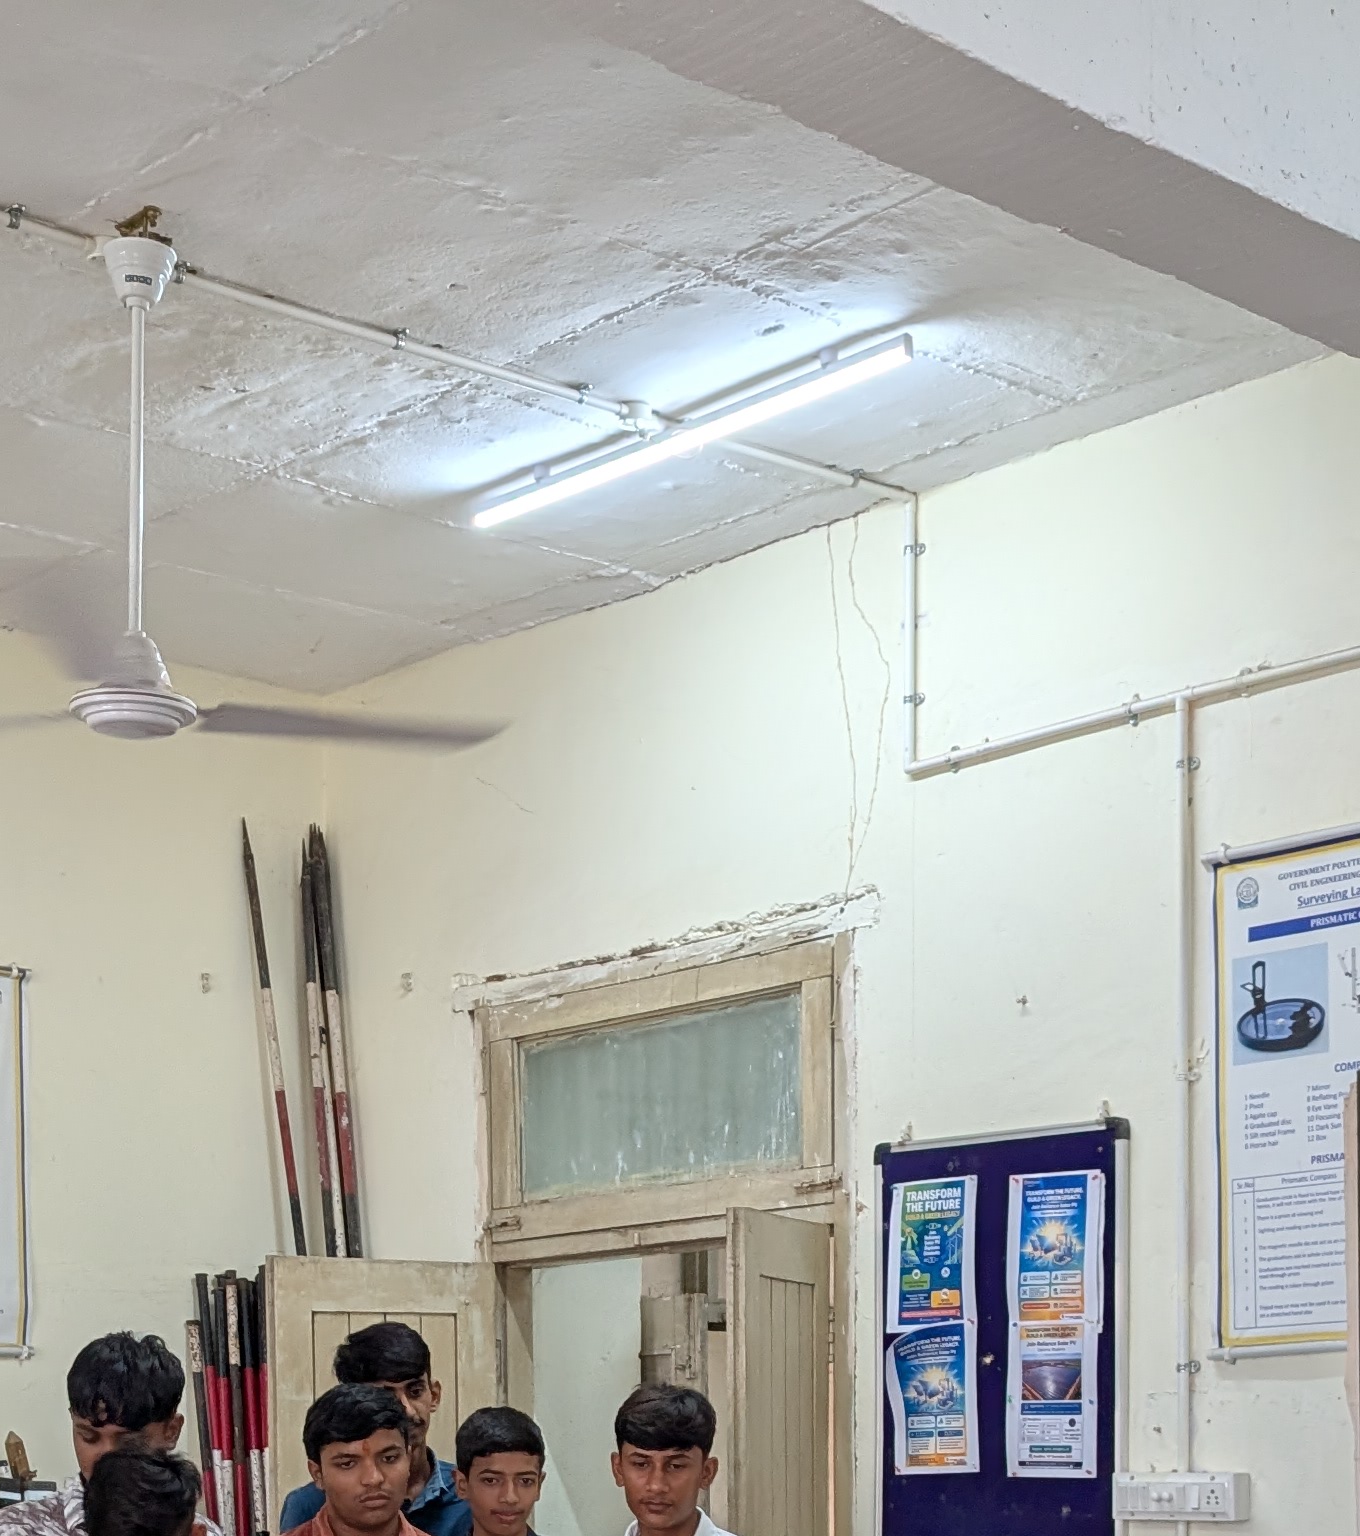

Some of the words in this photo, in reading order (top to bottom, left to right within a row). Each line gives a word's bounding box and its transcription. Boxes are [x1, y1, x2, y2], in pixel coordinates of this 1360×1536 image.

[1278, 863, 1330, 881] GOVERNMENT
[1288, 880, 1309, 891] CIVIL
[1310, 869, 1360, 889] ENGINEERING
[1297, 888, 1348, 909] Surveying
[1310, 910, 1357, 928] PRISMATIC
[1311, 1152, 1345, 1164] PRISMA
[906, 1187, 961, 1201] TRANSFORM
[906, 1202, 923, 1213] THE
[925, 1199, 961, 1211] FUTURE
